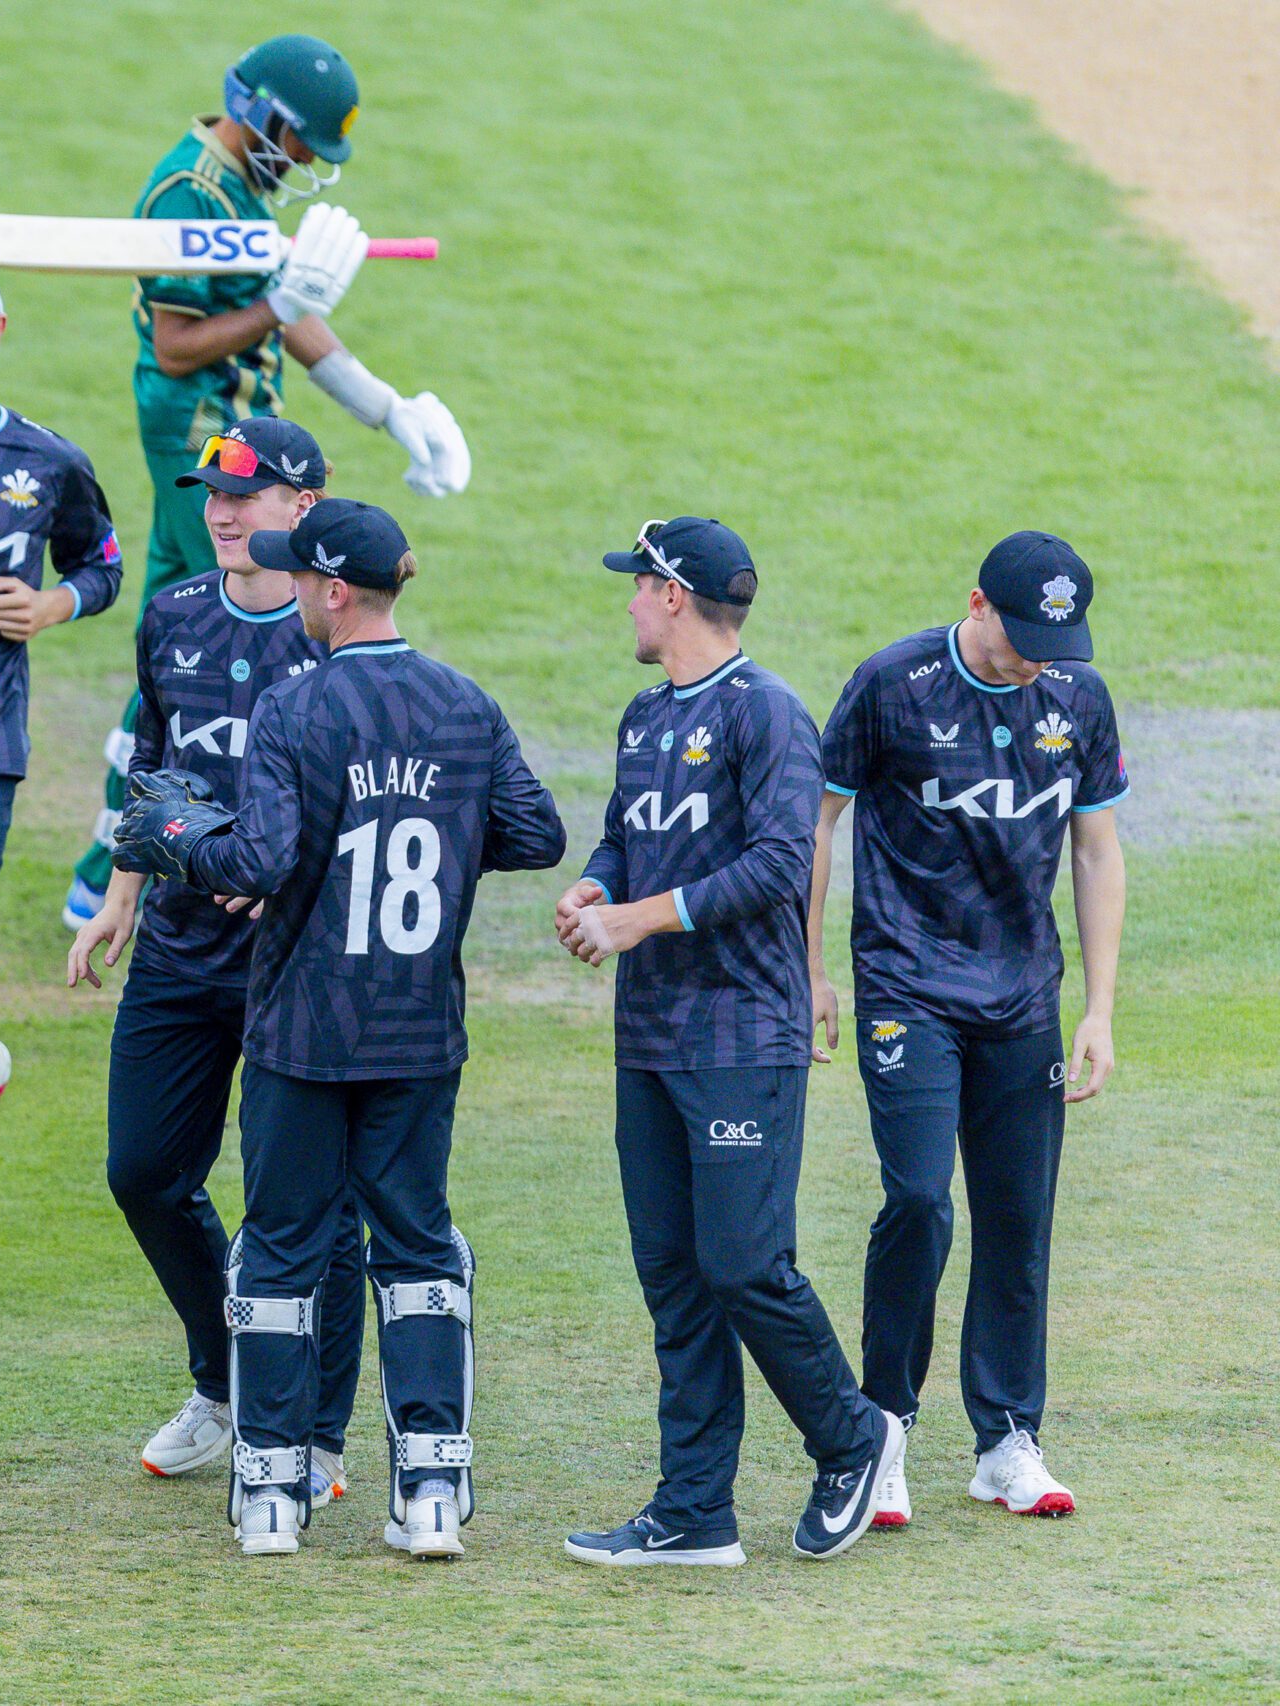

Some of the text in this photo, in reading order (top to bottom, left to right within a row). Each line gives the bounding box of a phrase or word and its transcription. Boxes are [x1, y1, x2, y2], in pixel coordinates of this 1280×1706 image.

[181, 226, 270, 262] DSC
[311, 560, 339, 576] CASTORE
[174, 584, 207, 599] KIA
[173, 667, 197, 675] CASTORE
[909, 661, 942, 680] KIA
[170, 710, 248, 758] KI
[348, 756, 441, 802] BLAKE
[922, 777, 1072, 819] KIA
[337, 817, 441, 955] 18
[879, 1062, 904, 1073] CASTORE
